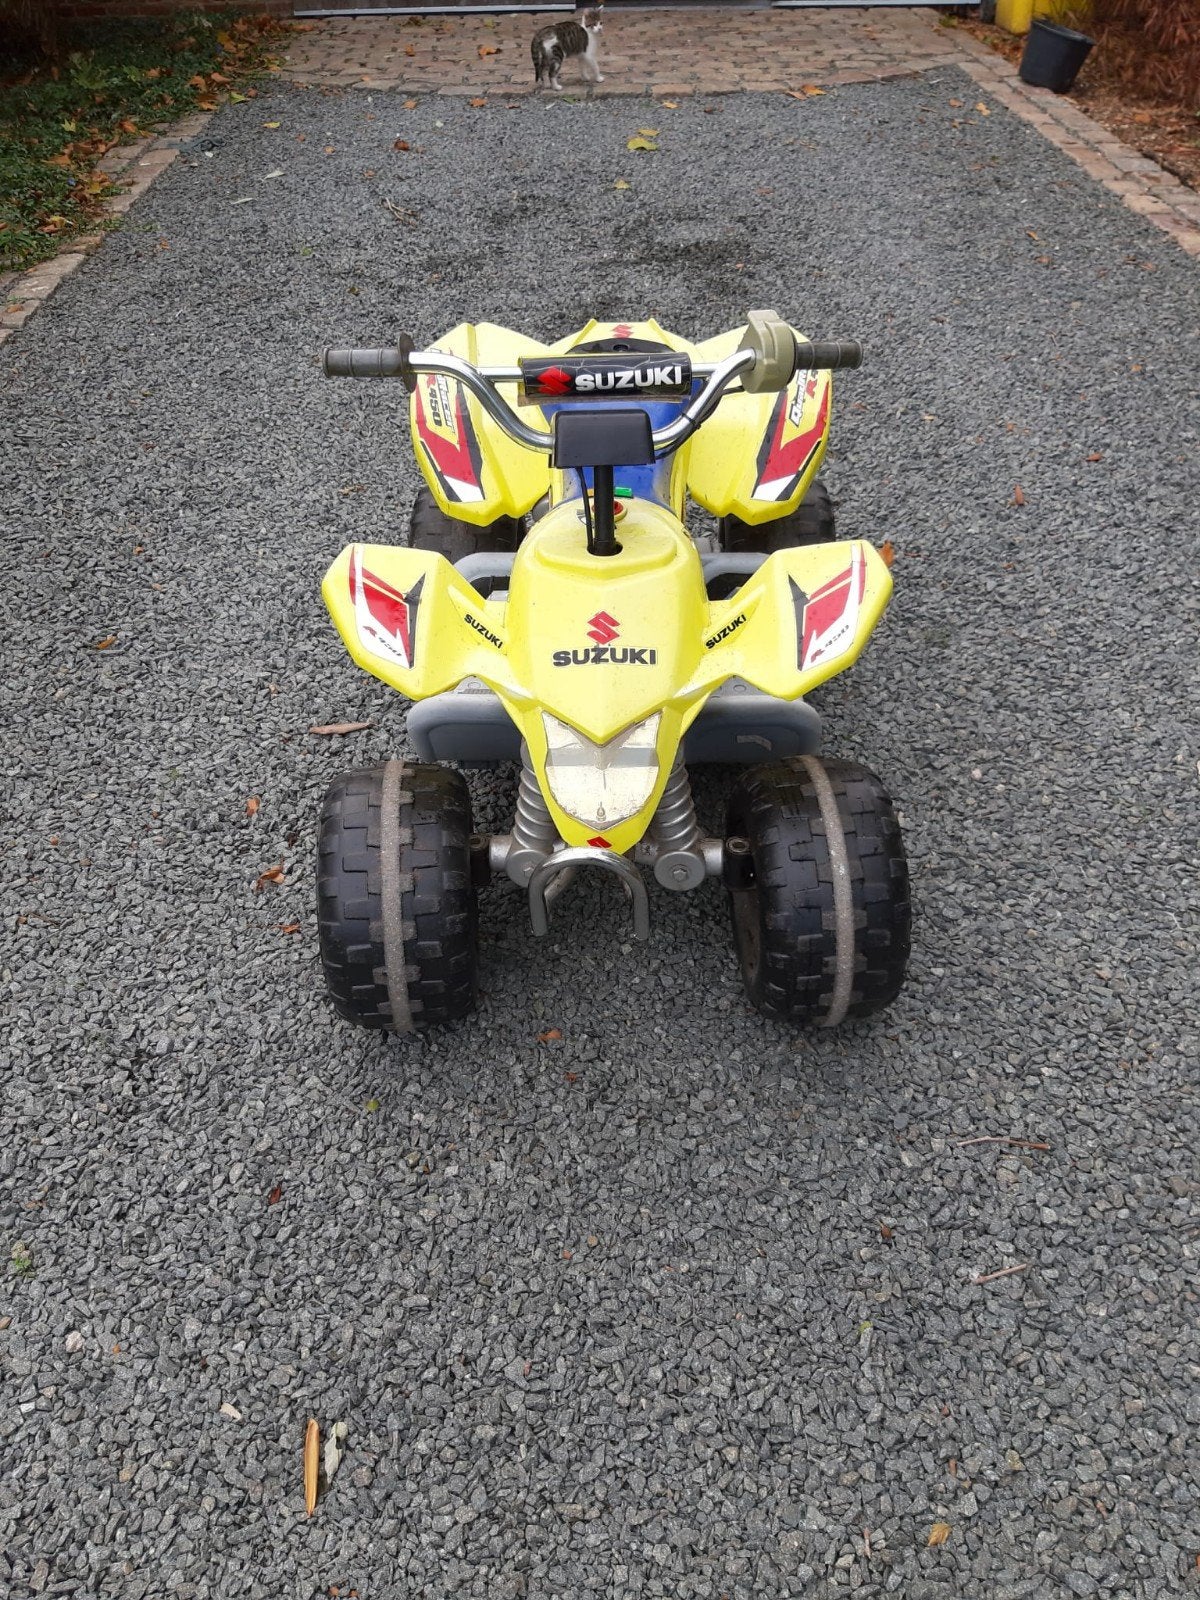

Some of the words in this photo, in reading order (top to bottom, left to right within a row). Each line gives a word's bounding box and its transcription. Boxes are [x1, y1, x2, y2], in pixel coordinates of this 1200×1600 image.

[575, 366, 682, 391] SUZUKI
[464, 613, 503, 649] SUZUKI
[705, 614, 747, 649] SUZUKI
[552, 647, 656, 667] SUZUKI
